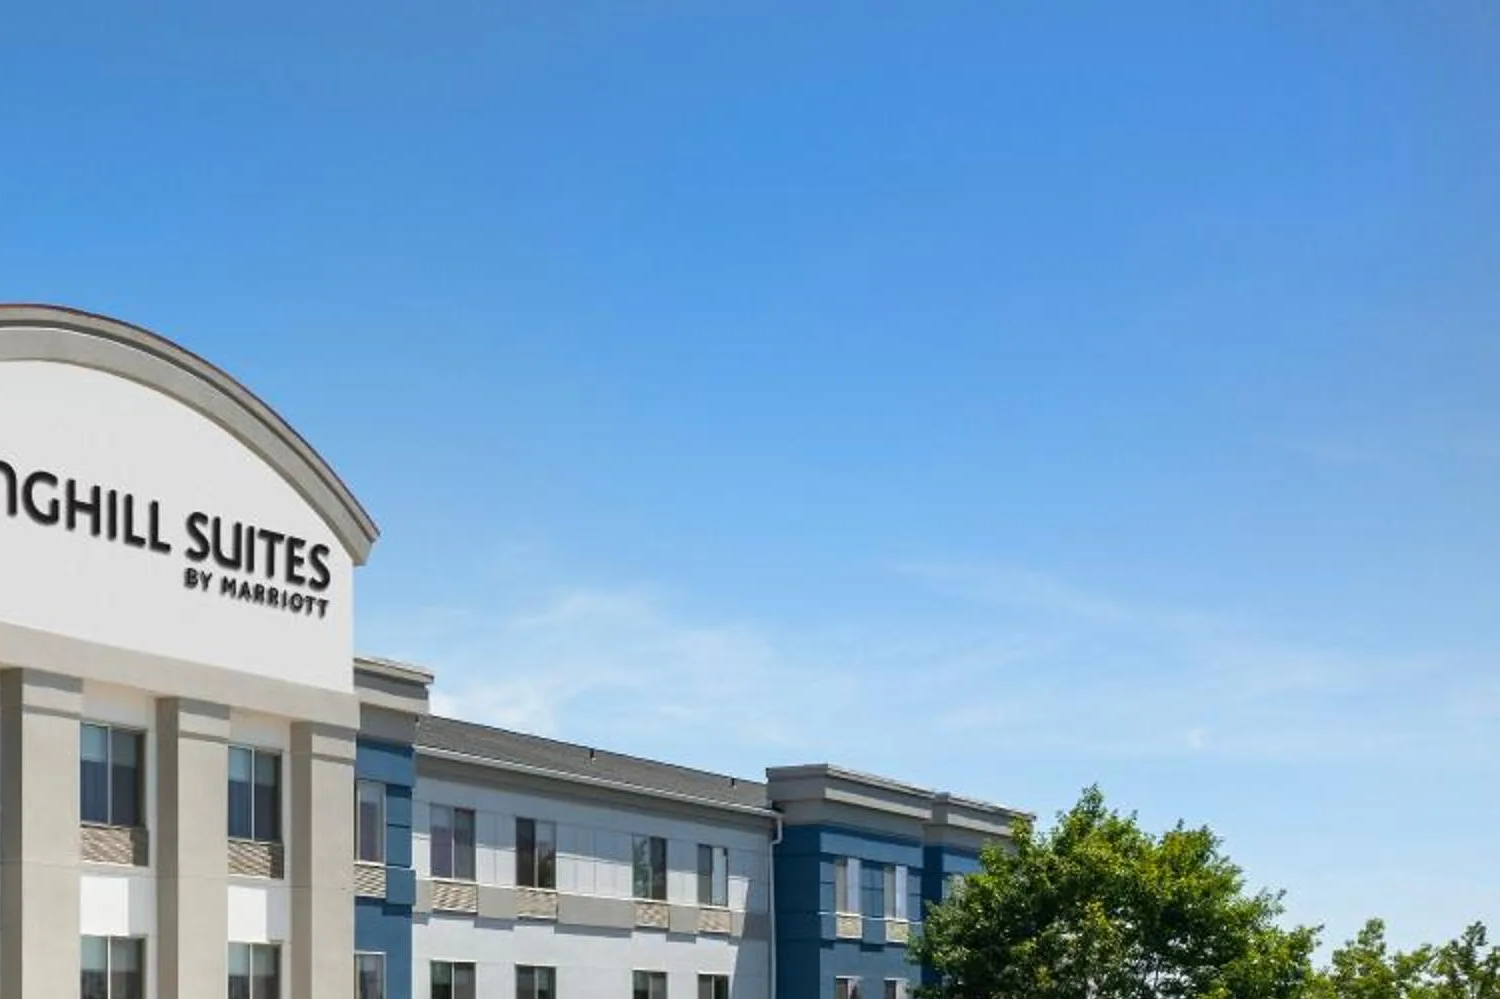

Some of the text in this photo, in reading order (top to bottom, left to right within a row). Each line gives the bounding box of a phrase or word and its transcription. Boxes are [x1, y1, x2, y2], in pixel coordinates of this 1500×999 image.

[185, 511, 331, 592] SUITES
[184, 567, 330, 618] BY MARRIOTT
